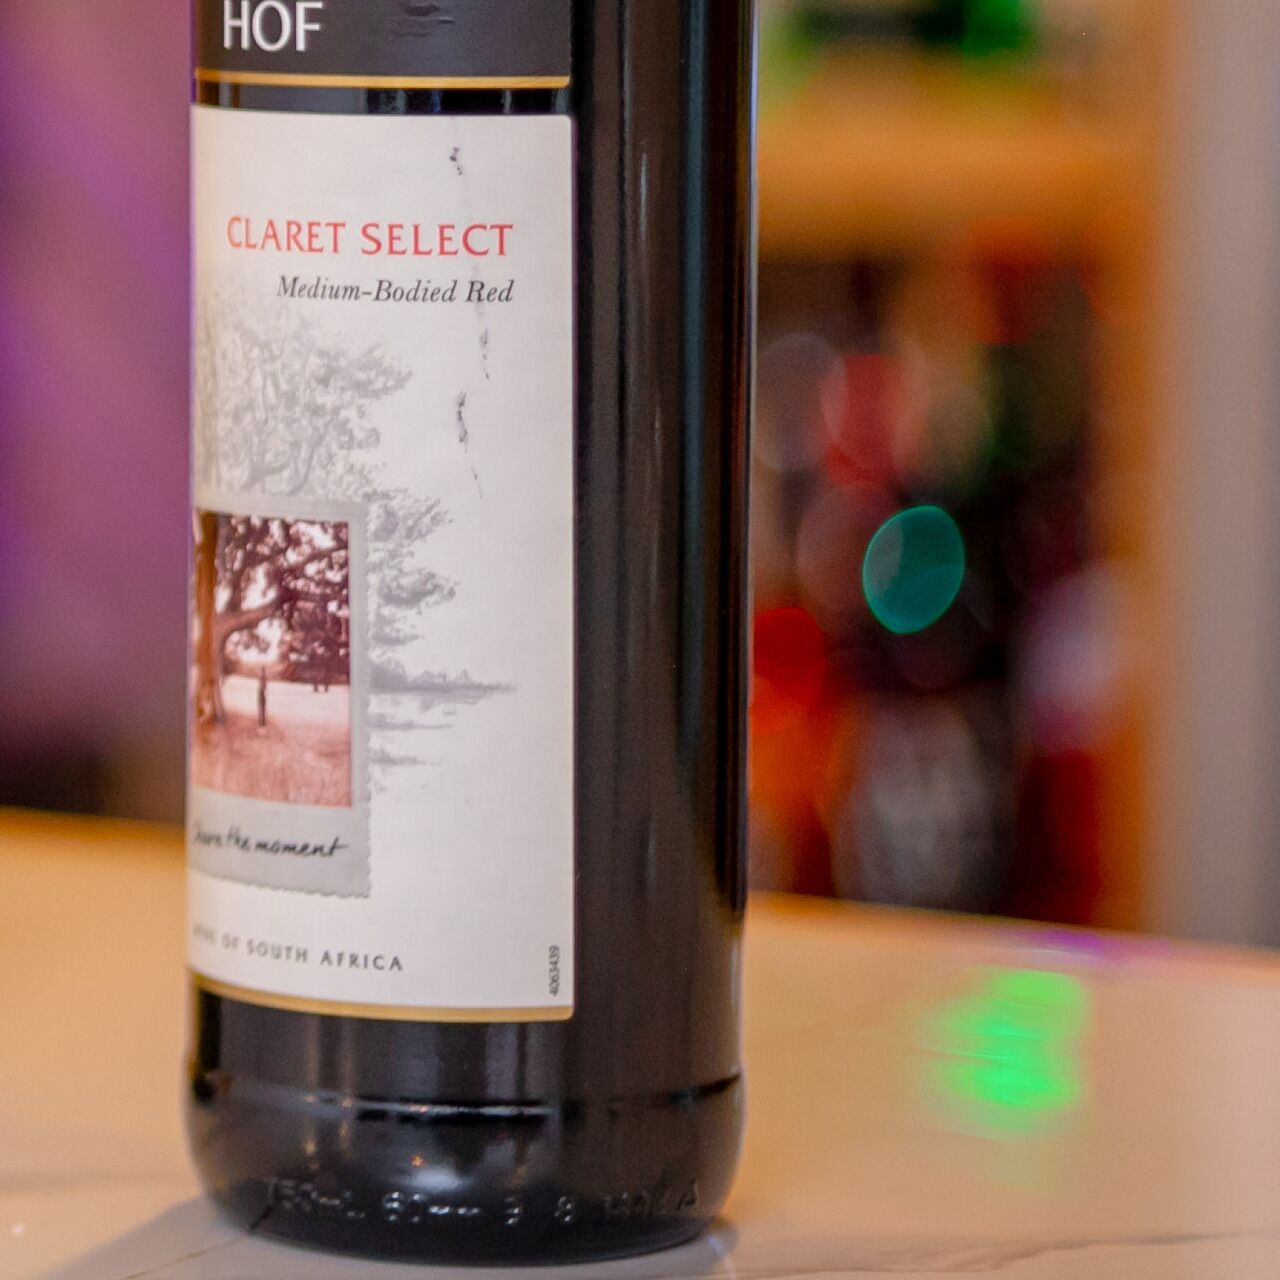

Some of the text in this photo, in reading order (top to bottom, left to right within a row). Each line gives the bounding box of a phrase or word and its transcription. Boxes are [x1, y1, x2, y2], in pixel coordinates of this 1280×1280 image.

[226, 215, 514, 257] CLARET SELECT
[276, 274, 515, 304] Medium-Bodied Red
[254, 836, 349, 858] moment
[246, 938, 309, 964] SOUTH
[320, 949, 403, 972] AFRICA
